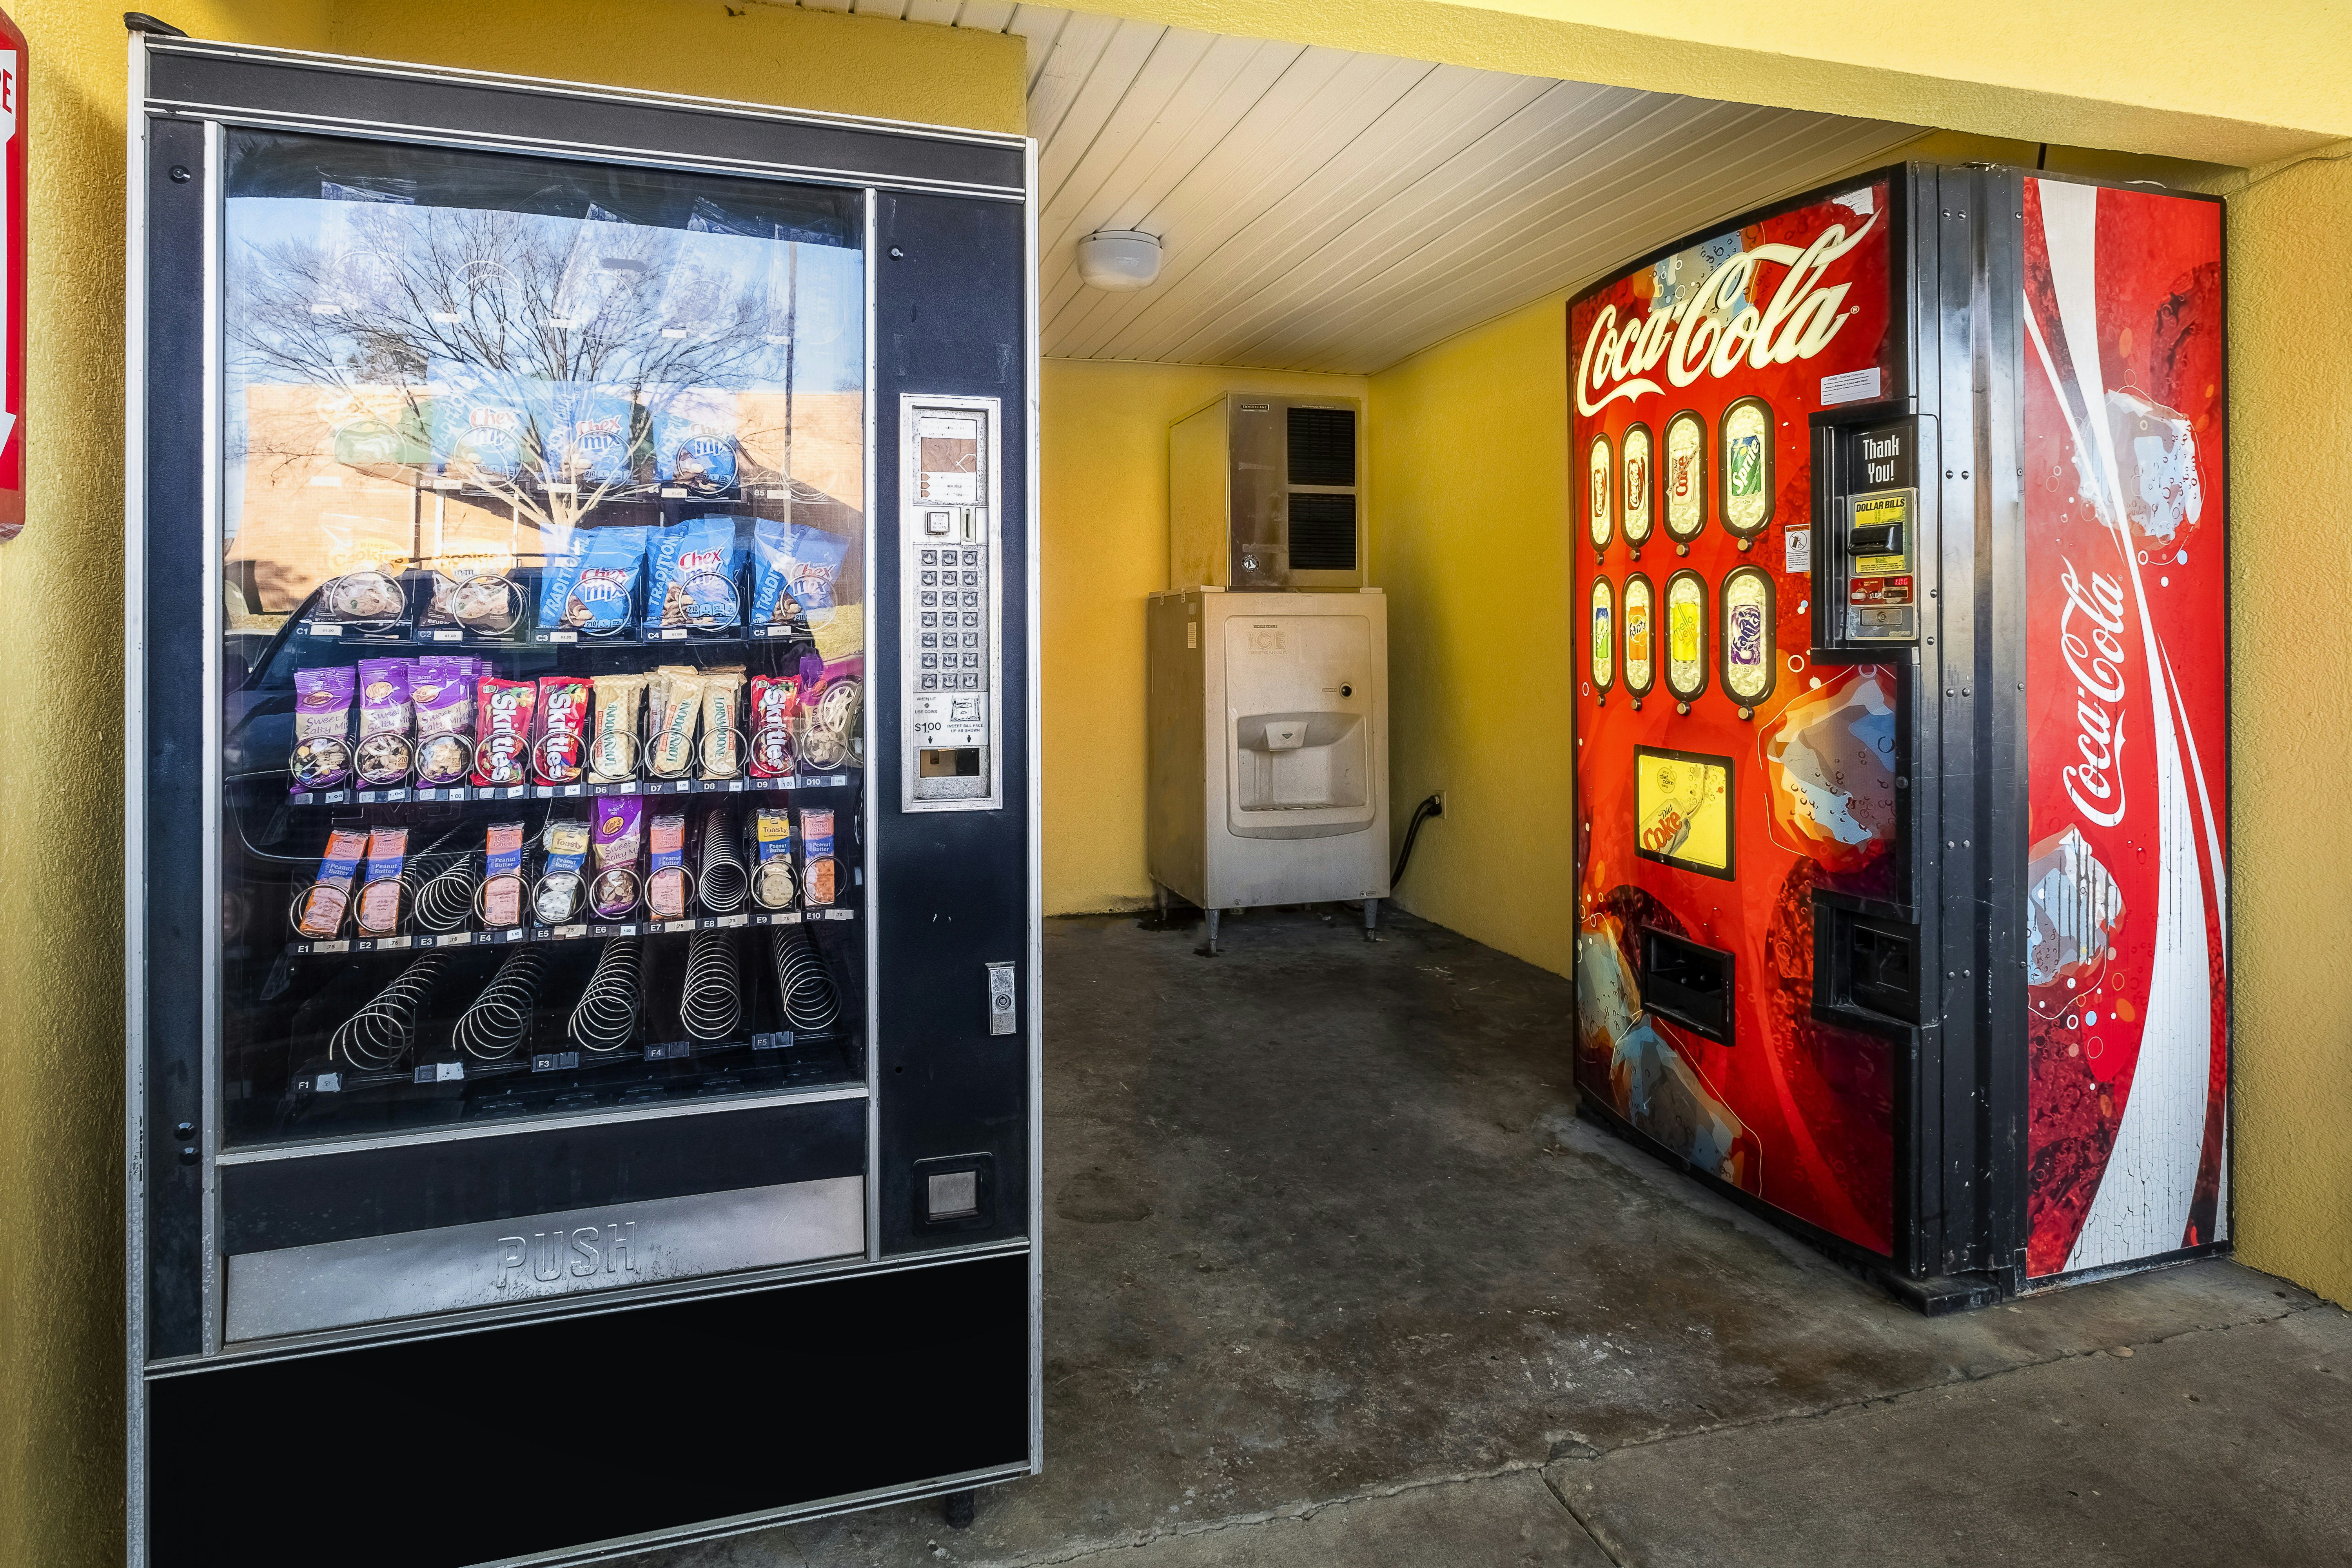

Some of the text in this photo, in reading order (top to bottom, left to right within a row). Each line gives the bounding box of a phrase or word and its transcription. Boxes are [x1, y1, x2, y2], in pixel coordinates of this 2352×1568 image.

[1577, 208, 1883, 417] Coca-Cola
[470, 407, 519, 427] Chex
[576, 415, 622, 435] Chex
[1863, 435, 1899, 460] Thank
[1733, 438, 1759, 494] Sprite
[1868, 460, 1894, 484] You!
[1630, 462, 1639, 508] Coca-Cola
[1856, 498, 1905, 512] DOLLAR BILLS
[679, 546, 726, 570] Chex
[790, 561, 837, 580] Chex
[296, 627, 309, 635] C1
[1629, 620, 1646, 639] Fanta
[1673, 616, 1693, 637] mello
[1679, 623, 1695, 644] yello
[1248, 632, 1286, 649] ICE
[2060, 554, 2126, 827] Coca-Cola
[307, 715, 339, 727] Sweet
[421, 722, 445, 735] Salty
[764, 689, 788, 769] Skittles
[915, 722, 941, 733] $1.00
[302, 724, 331, 737] Salty
[491, 693, 517, 781] Skittles
[546, 693, 571, 779] Skittles
[1659, 804, 1673, 819] Diet
[605, 818, 622, 833] Kar's
[1643, 811, 1682, 852] Coke
[333, 846, 355, 855] Chee
[336, 840, 357, 849] Toast
[556, 838, 583, 849] Toasty
[605, 844, 632, 855] Sweet
[330, 863, 352, 871] Peanut
[605, 852, 627, 865] Salty
[328, 868, 349, 877] Butter
[538, 1059, 550, 1068] F3
[298, 1081, 309, 1089] F1
[494, 1221, 637, 1289] PUSH
